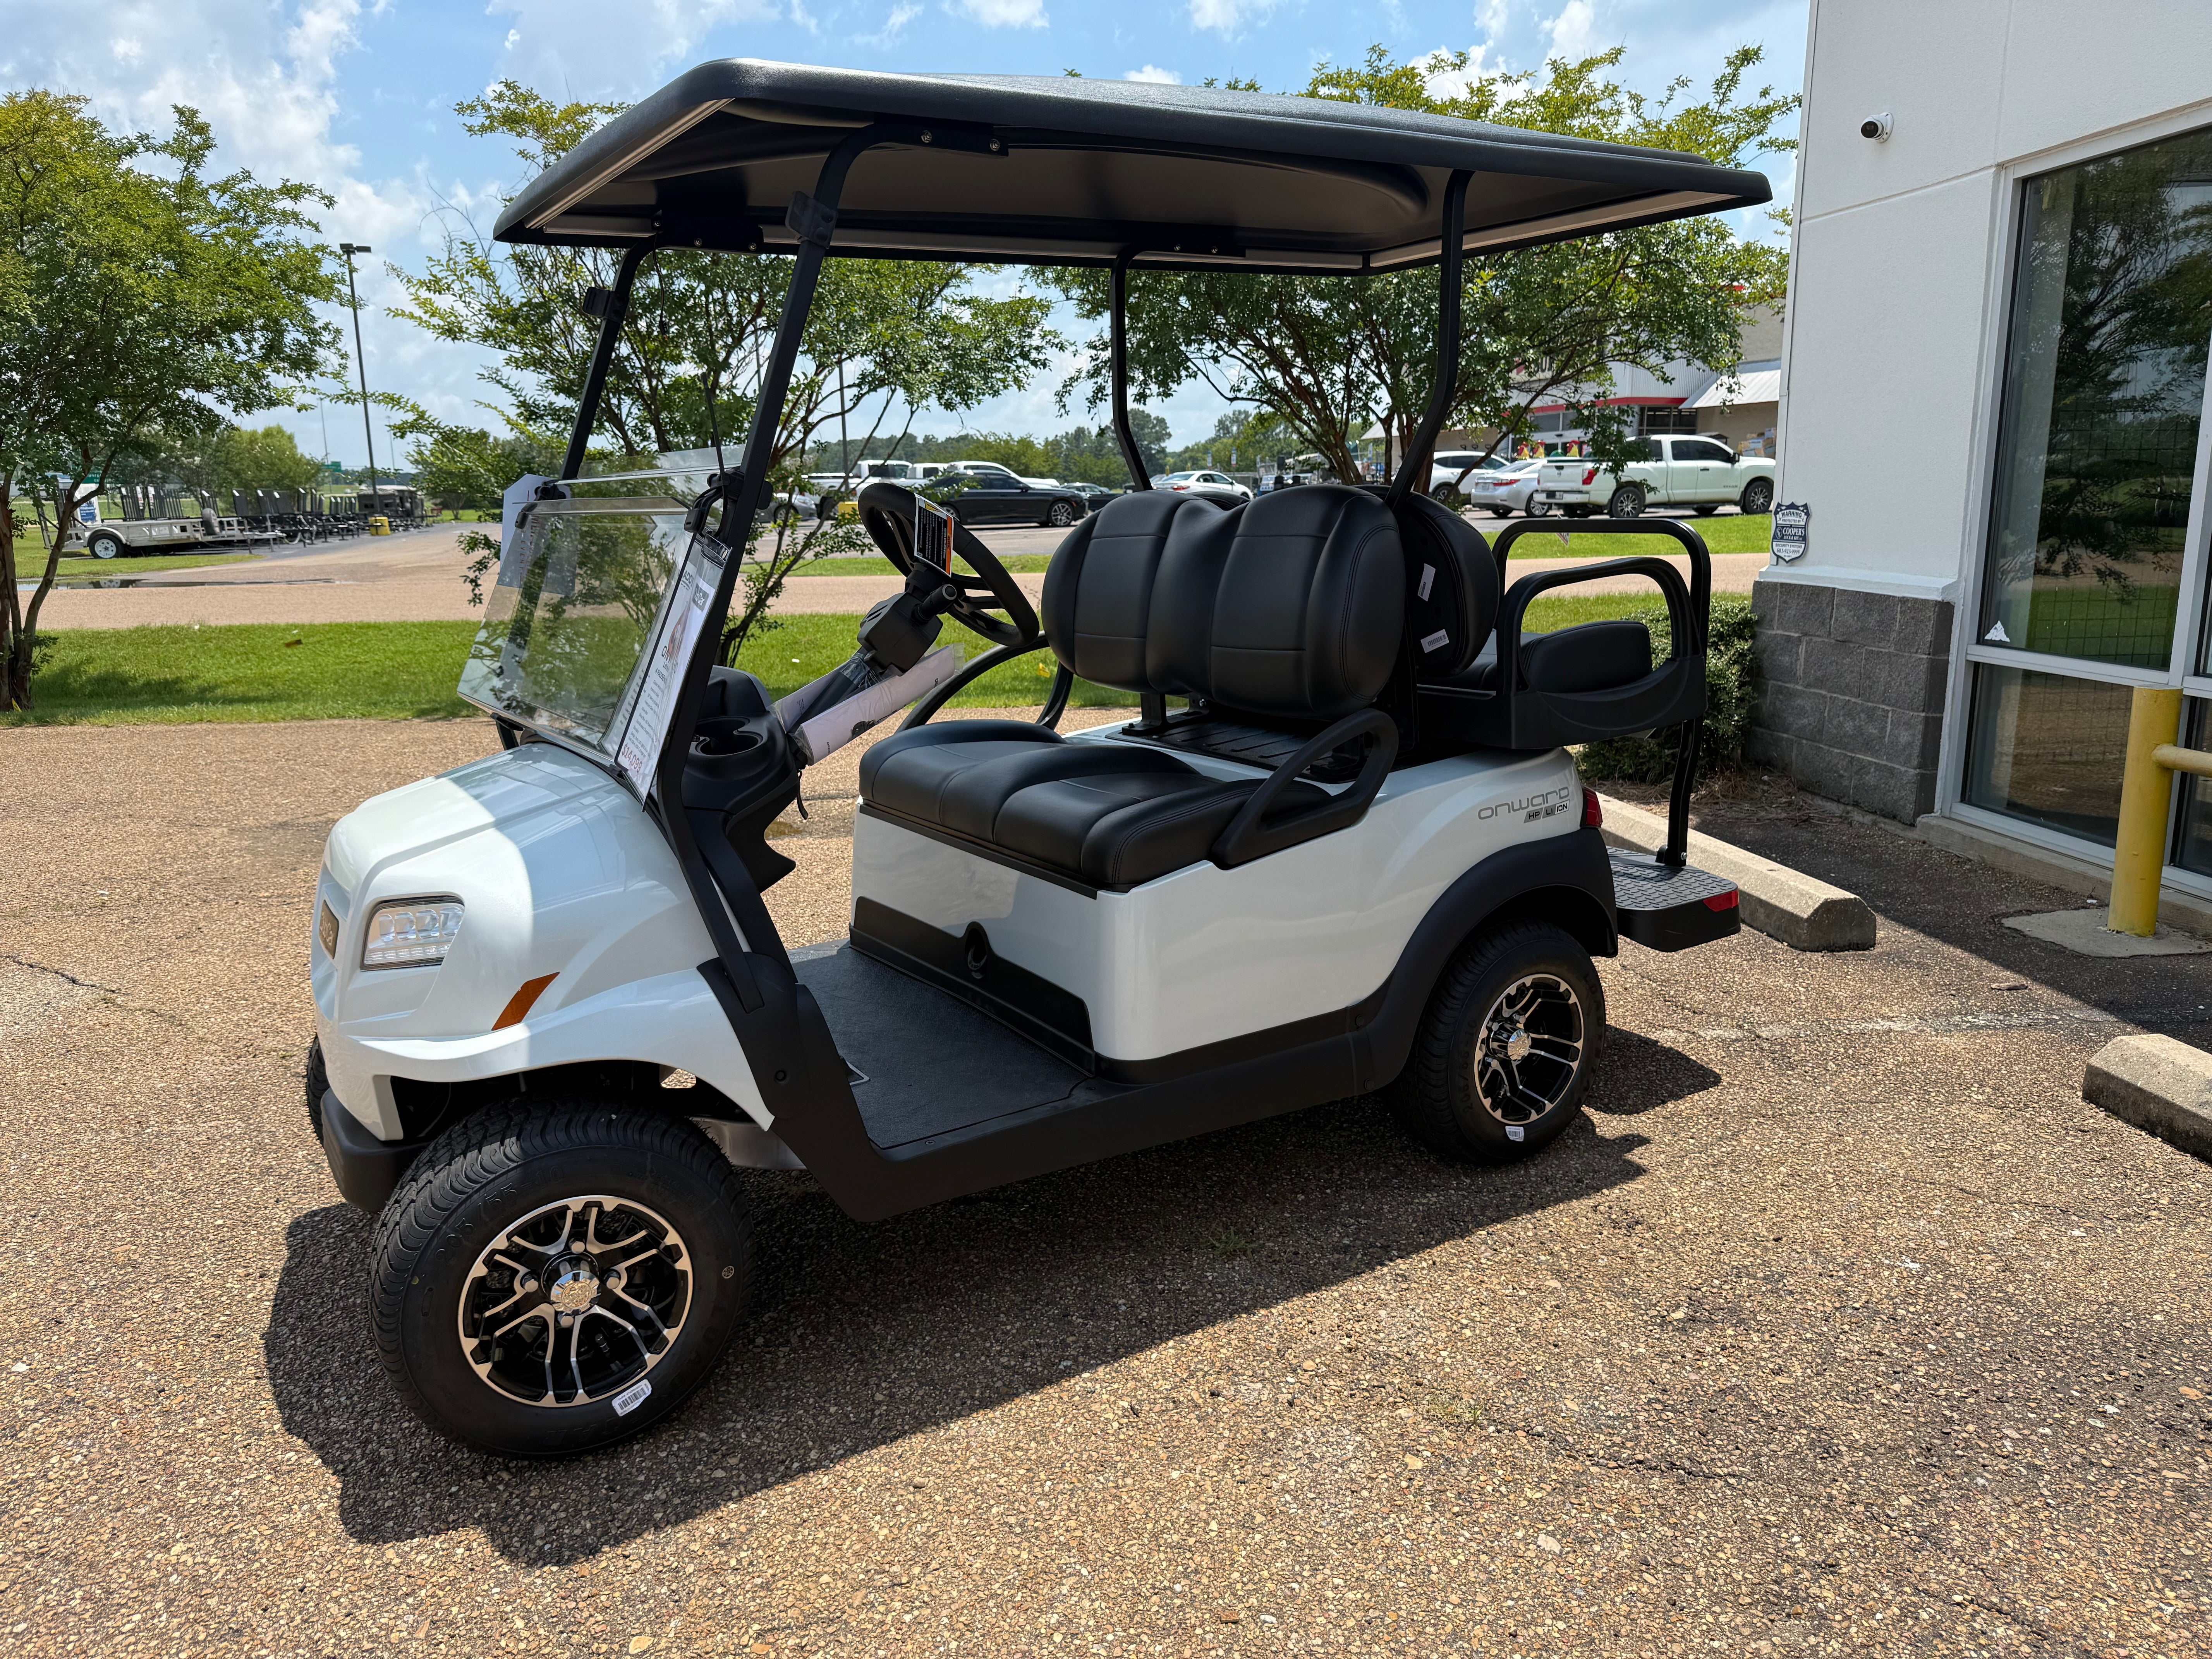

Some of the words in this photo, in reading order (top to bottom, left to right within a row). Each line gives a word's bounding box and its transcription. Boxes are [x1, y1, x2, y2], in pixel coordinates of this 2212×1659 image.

[622, 742, 642, 773] $14,099
[1478, 786, 1569, 820] onward
[1528, 811, 1540, 819] HP
[1546, 807, 1553, 815] LI
[1556, 802, 1568, 812] ION
